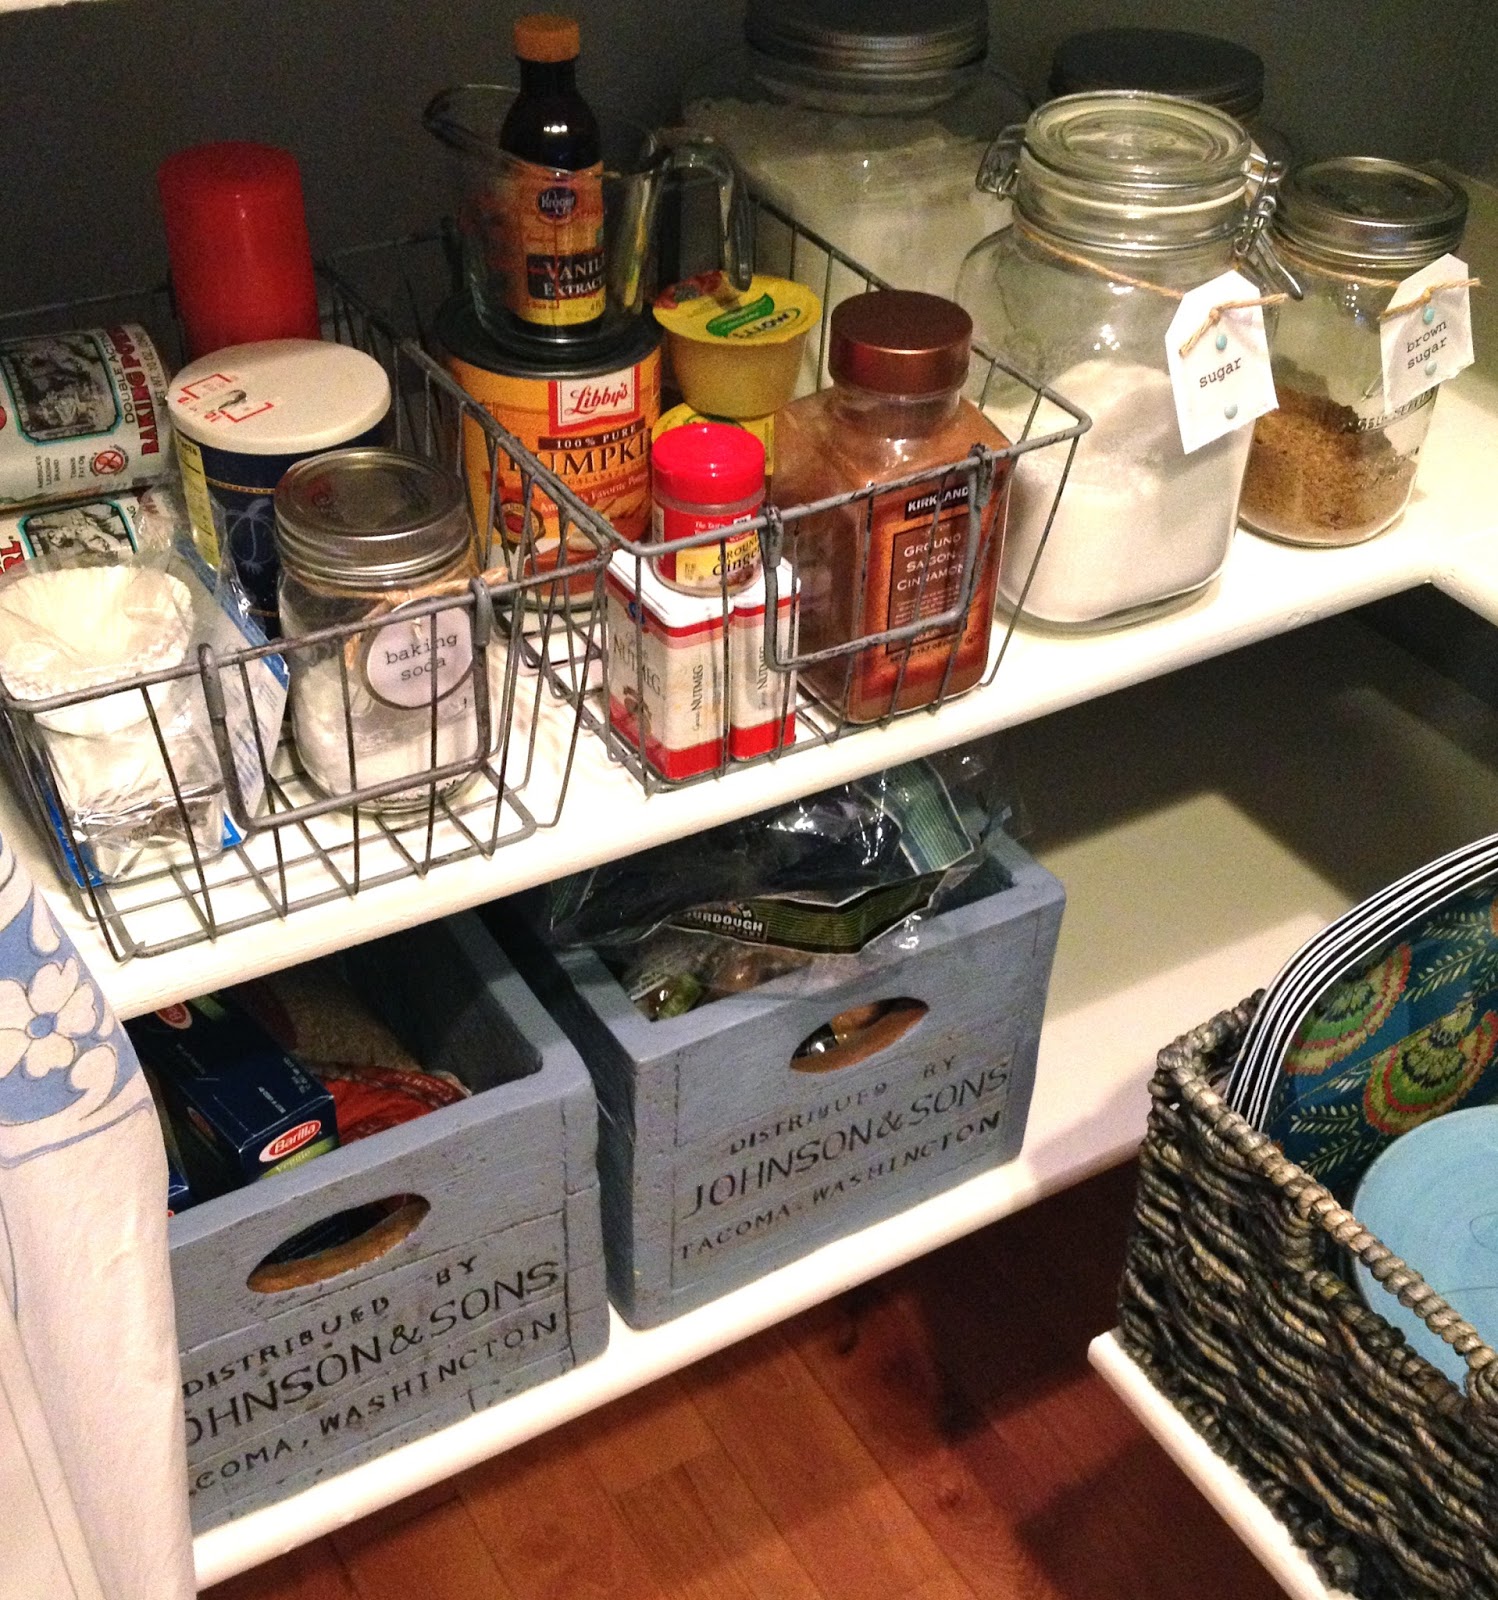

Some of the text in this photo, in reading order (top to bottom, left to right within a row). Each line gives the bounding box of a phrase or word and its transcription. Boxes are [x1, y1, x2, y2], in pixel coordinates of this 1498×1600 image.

[1406, 320, 1447, 353] brown
[1406, 338, 1448, 369] sugar
[1199, 357, 1242, 388] sugar
[124, 371, 159, 456] BAKING
[564, 382, 628, 415] Libby's
[556, 423, 637, 450] 100% PURE
[907, 487, 969, 512] KIRKAND
[906, 551, 956, 573] SAGON
[385, 633, 459, 666] baking
[690, 664, 704, 712] NUTMEG
[683, 908, 764, 933] URDOUGH
[274, 1124, 316, 1154] Barilla
[436, 1254, 478, 1287] BY
[184, 1260, 561, 1447] OHNSON&SONS
[188, 1438, 309, 1497] COMA,
